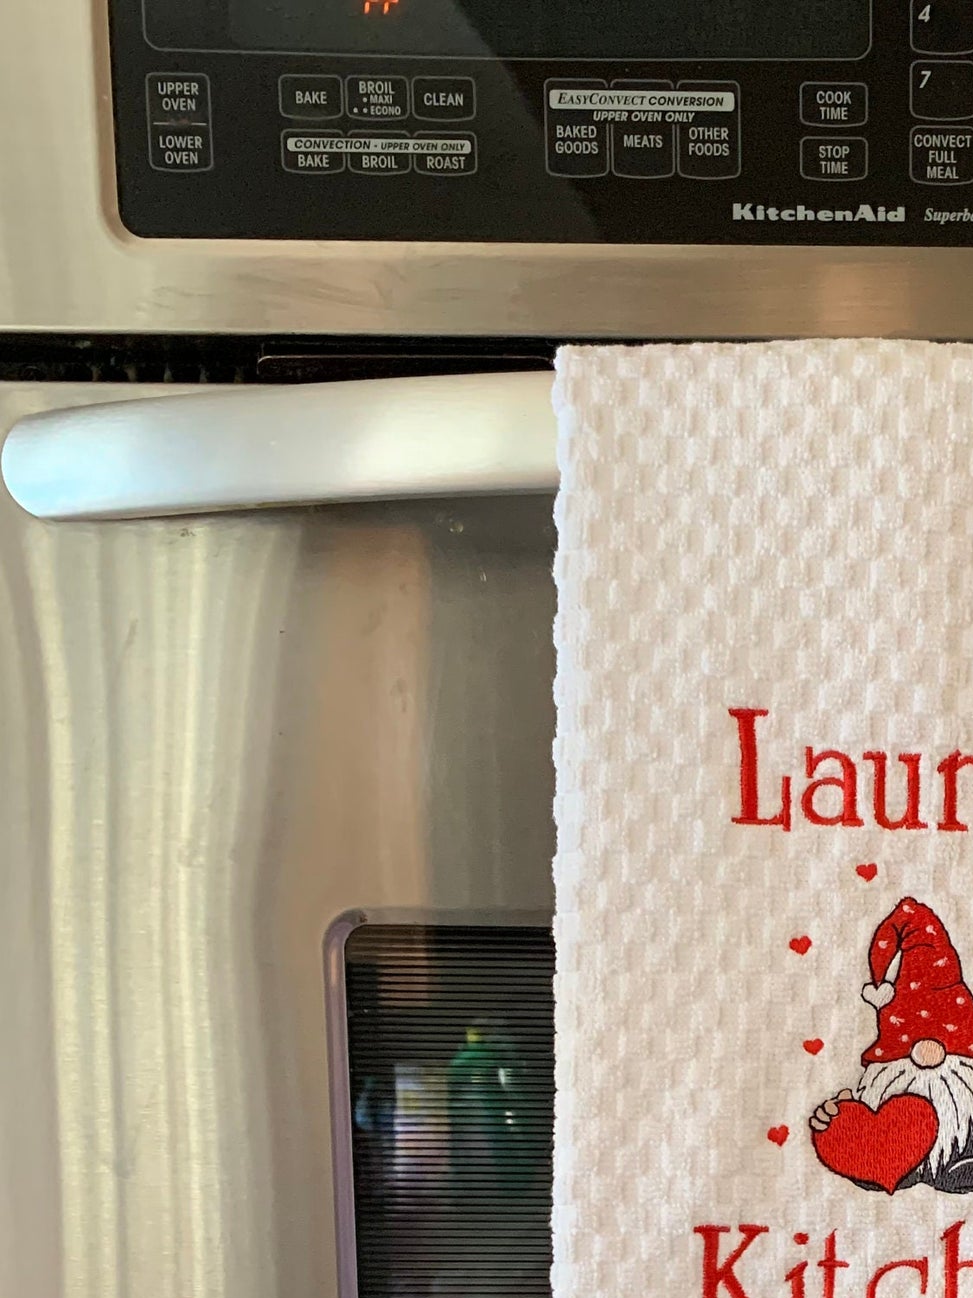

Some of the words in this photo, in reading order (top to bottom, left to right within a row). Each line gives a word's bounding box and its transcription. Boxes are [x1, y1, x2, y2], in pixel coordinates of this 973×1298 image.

[918, 4, 931, 23] 4
[919, 70, 932, 89] 7
[157, 81, 199, 95] UPPER
[358, 81, 395, 95] BROIL
[161, 97, 196, 111] OVEN
[295, 91, 328, 104] BAKE
[370, 95, 393, 104] MAXI
[423, 93, 464, 106] CLEAN
[648, 96, 724, 107] CONVERSION
[816, 91, 852, 105] COOK
[370, 106, 401, 116] ECONO
[593, 111, 628, 122] UPPER
[631, 111, 662, 122] OVEN
[665, 111, 696, 123] ONLY
[819, 107, 849, 121] TIME
[556, 125, 597, 139] BAKED
[688, 127, 729, 141] OTHER
[159, 135, 203, 149] LOWER
[294, 139, 371, 150] CONVECTION
[380, 142, 409, 151] UPPER
[412, 142, 438, 151] OVEN
[440, 142, 466, 152] ONLY
[555, 141, 599, 154] GOODS
[623, 135, 663, 148] MEATS
[913, 134, 972, 148] CONVECT
[688, 142, 730, 156] FOODS
[818, 146, 850, 159] STOP
[164, 151, 199, 165] OVEN
[297, 154, 330, 168] BAKE
[361, 155, 398, 169] BROIL
[426, 156, 466, 170] ROAST
[928, 150, 957, 164] FULL
[819, 161, 849, 174] TIME
[926, 166, 959, 179] MEAL
[732, 203, 906, 222] KitchenAid
